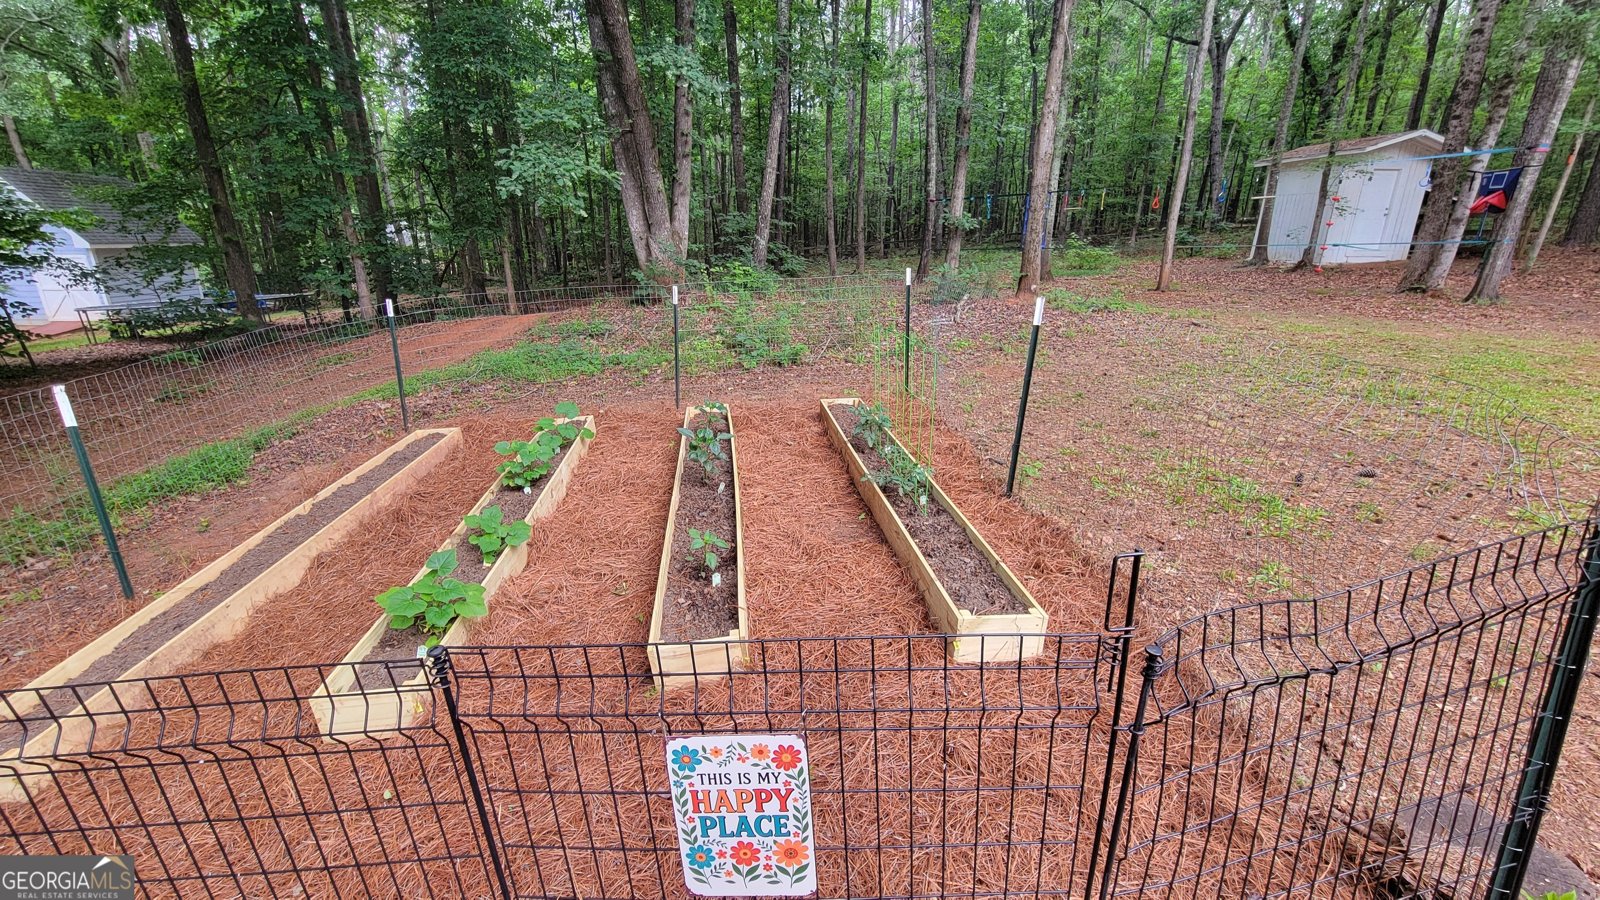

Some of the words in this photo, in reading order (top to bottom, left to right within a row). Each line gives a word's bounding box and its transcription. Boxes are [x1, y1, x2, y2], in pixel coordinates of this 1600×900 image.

[697, 772, 732, 785] THIS
[738, 772, 752, 784] IS
[758, 772, 782, 784] MY
[688, 788, 794, 814] HAPPY
[698, 814, 791, 838] PLACE
